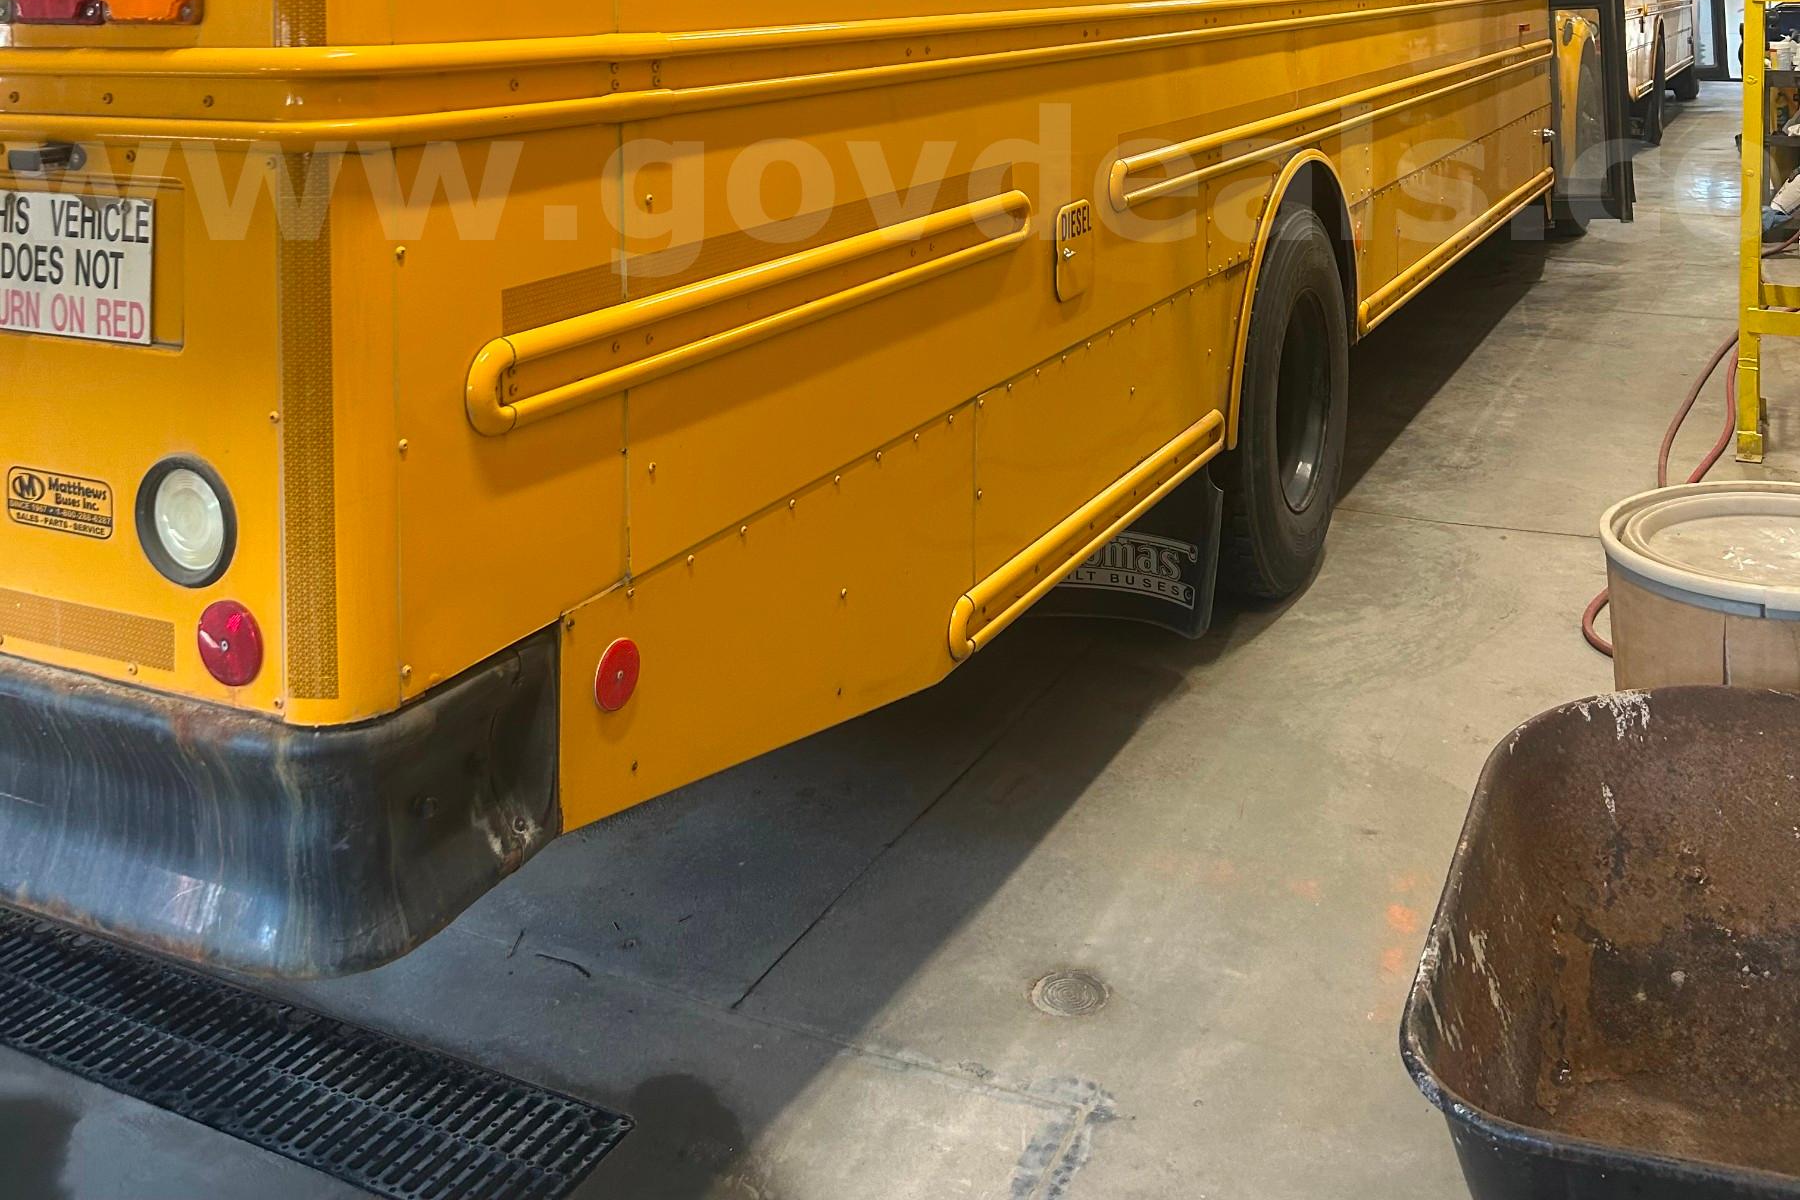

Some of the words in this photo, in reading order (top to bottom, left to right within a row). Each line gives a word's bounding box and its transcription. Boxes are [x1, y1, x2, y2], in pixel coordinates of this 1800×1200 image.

[51, 199, 149, 244] VEHICLE
[1061, 205, 1092, 242] DIESEL
[1, 242, 64, 285] DOES
[75, 248, 124, 290] NOT
[0, 289, 40, 329] URN
[51, 293, 85, 333] ON
[97, 298, 145, 340] RED
[48, 476, 107, 501] Matthews
[55, 493, 80, 508] Buses
[83, 497, 99, 512] Inc.
[16, 511, 39, 523] SALES
[44, 517, 69, 529] PARTS
[73, 522, 106, 536] SERVICE
[1110, 573, 1180, 597] BUSES
